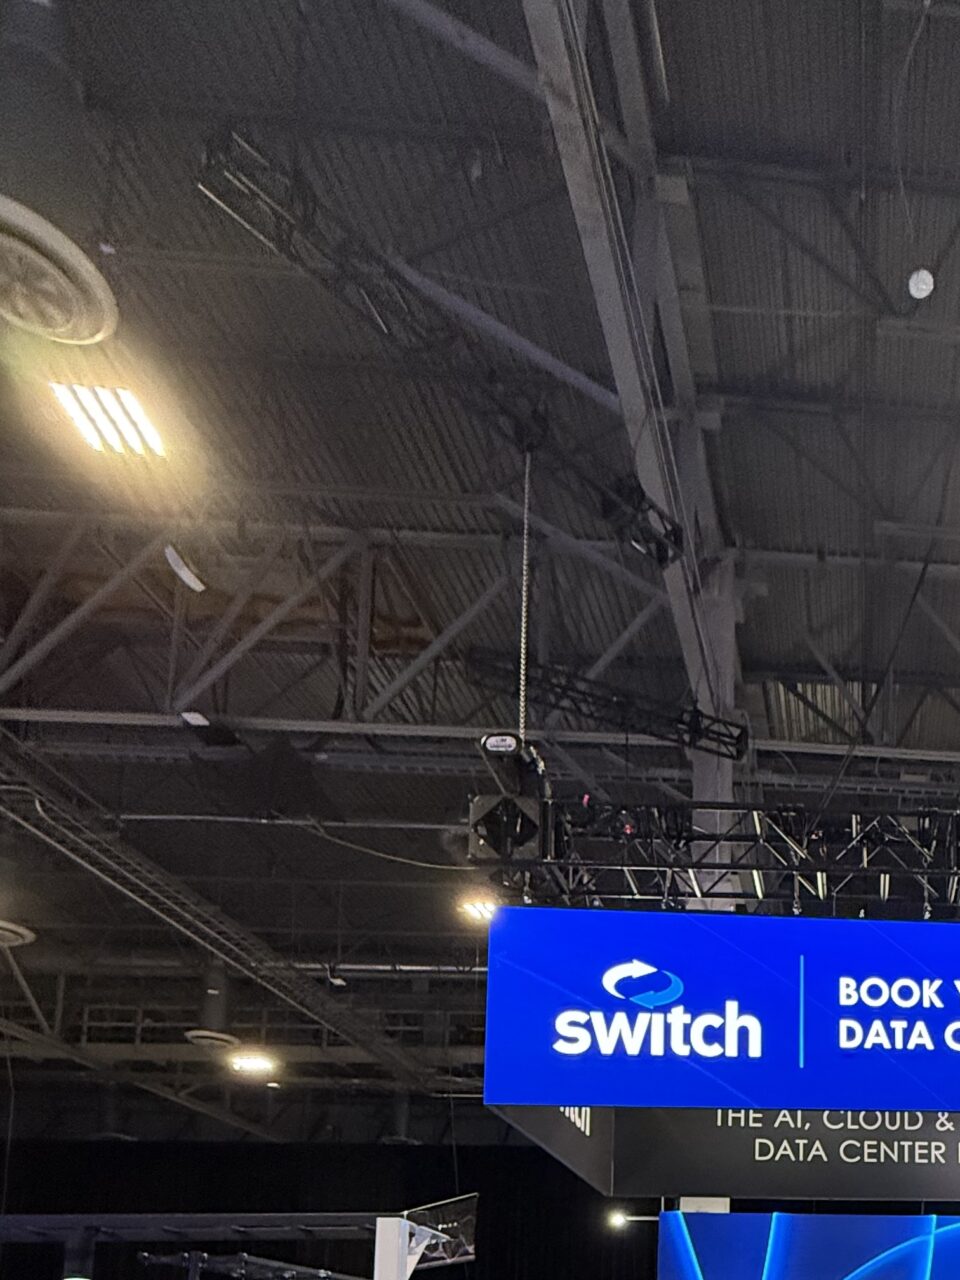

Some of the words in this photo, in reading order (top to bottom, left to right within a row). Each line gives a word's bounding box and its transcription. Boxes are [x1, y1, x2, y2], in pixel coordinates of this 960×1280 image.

[839, 977, 944, 1008] BOOK
[552, 999, 763, 1058] switch
[839, 1019, 934, 1050] DATA
[822, 1110, 924, 1131] CLOUD
[754, 1138, 828, 1162] DATA
[839, 1139, 946, 1164] CENTER
